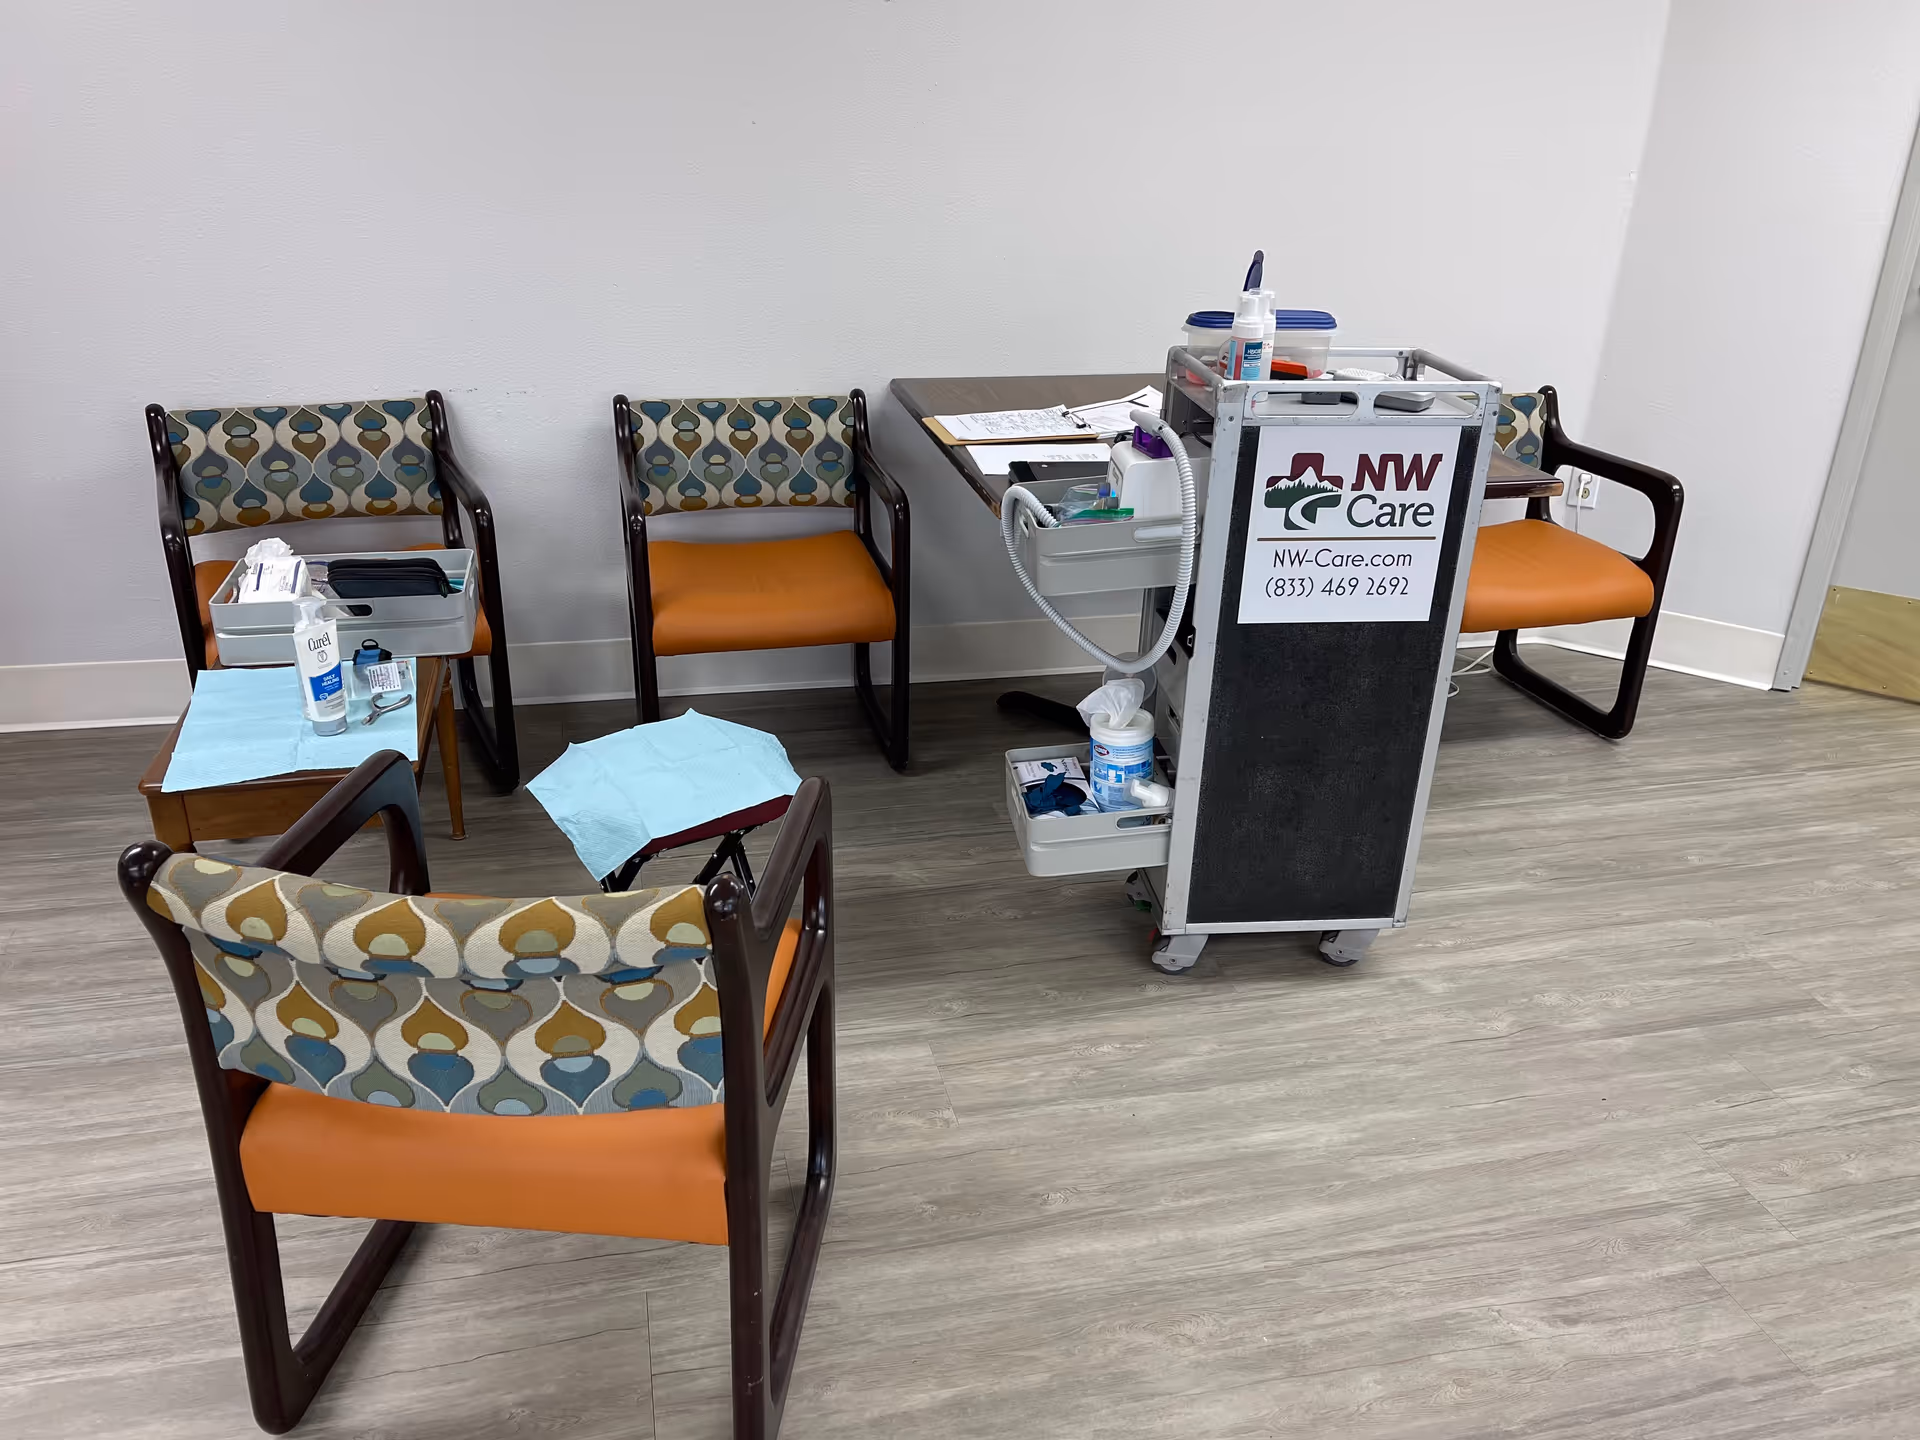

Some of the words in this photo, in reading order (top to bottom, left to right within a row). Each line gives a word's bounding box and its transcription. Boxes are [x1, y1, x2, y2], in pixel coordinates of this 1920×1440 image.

[1351, 453, 1443, 491] NW
[1347, 493, 1435, 528] Care
[1273, 548, 1412, 568] NW-Care.com
[1265, 576, 1314, 598] (833)
[1321, 577, 1359, 596] 469
[1366, 576, 1409, 596] 2692
[308, 632, 331, 651] Curél
